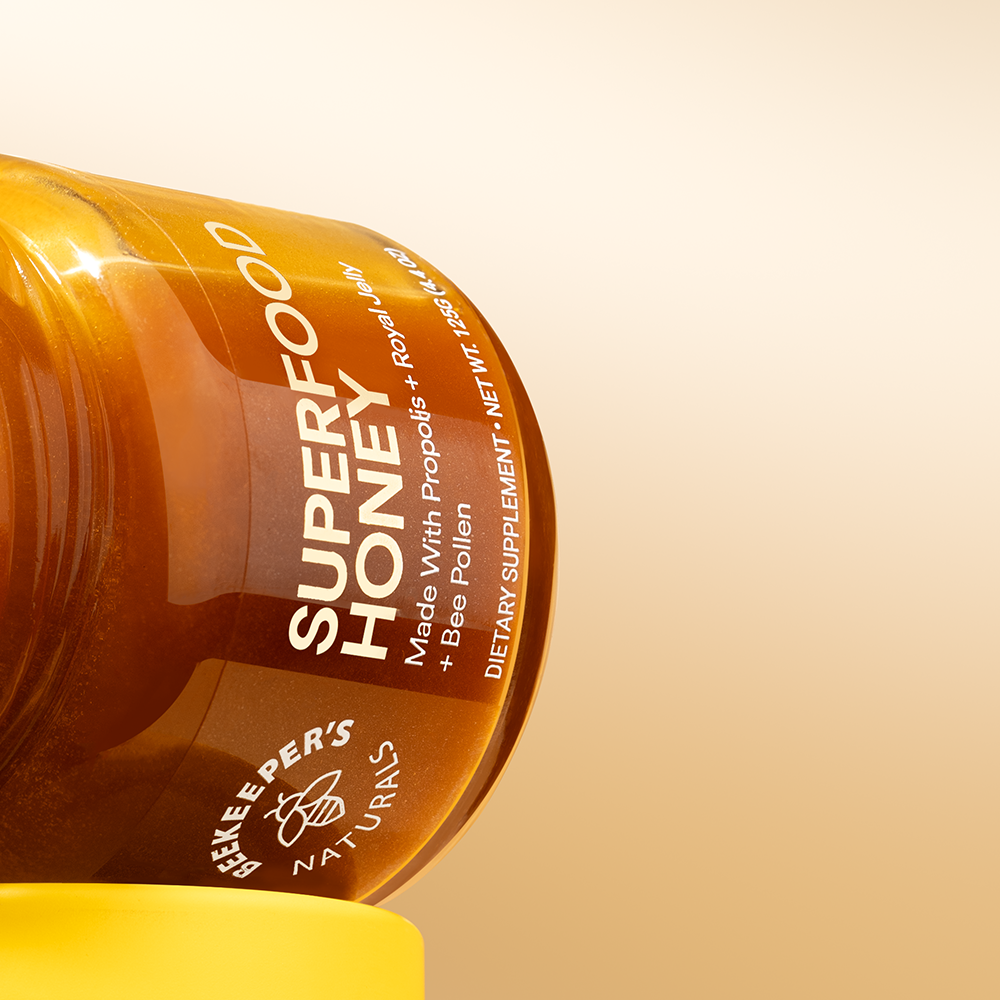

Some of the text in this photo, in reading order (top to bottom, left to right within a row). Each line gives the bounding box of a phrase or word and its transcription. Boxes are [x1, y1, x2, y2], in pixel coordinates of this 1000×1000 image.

[338, 261, 381, 306] Jelly
[433, 297, 470, 338] 125G
[367, 307, 414, 369] Royal
[460, 342, 488, 373] WT.
[474, 375, 504, 418] NET
[203, 221, 351, 655] SUPERFOOD
[410, 396, 441, 503] Propolis
[337, 368, 405, 660] HONEY
[419, 510, 442, 577] With
[450, 503, 472, 586] Pollen
[491, 432, 520, 583] SUPPLEMENT
[404, 585, 438, 667] Made
[440, 594, 467, 647] Bee
[484, 585, 517, 679] DIETARY
[211, 719, 355, 879] BEEKEEPER'S
[292, 740, 400, 876] NATURALS
